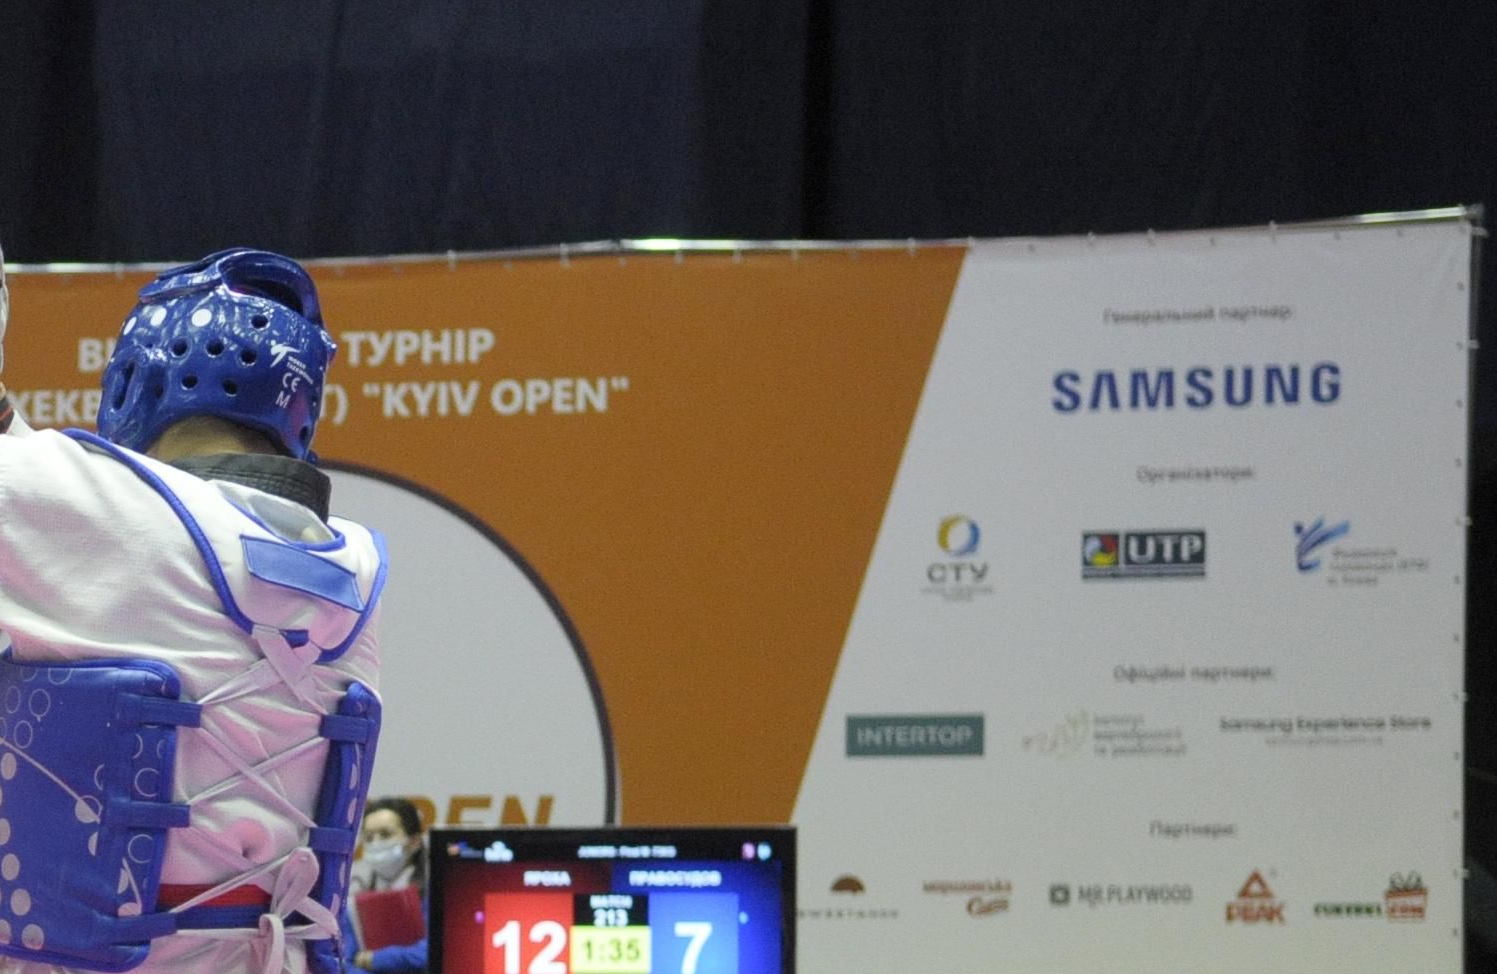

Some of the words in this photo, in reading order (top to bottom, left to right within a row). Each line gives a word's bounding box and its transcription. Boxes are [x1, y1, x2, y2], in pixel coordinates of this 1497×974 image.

[340, 328, 496, 366] ТУРНІР
[1051, 361, 1341, 414] SAMSUNG
[1125, 530, 1203, 563] UTP
[857, 724, 974, 747] INTERTOP
[582, 938, 642, 961] 1:35
